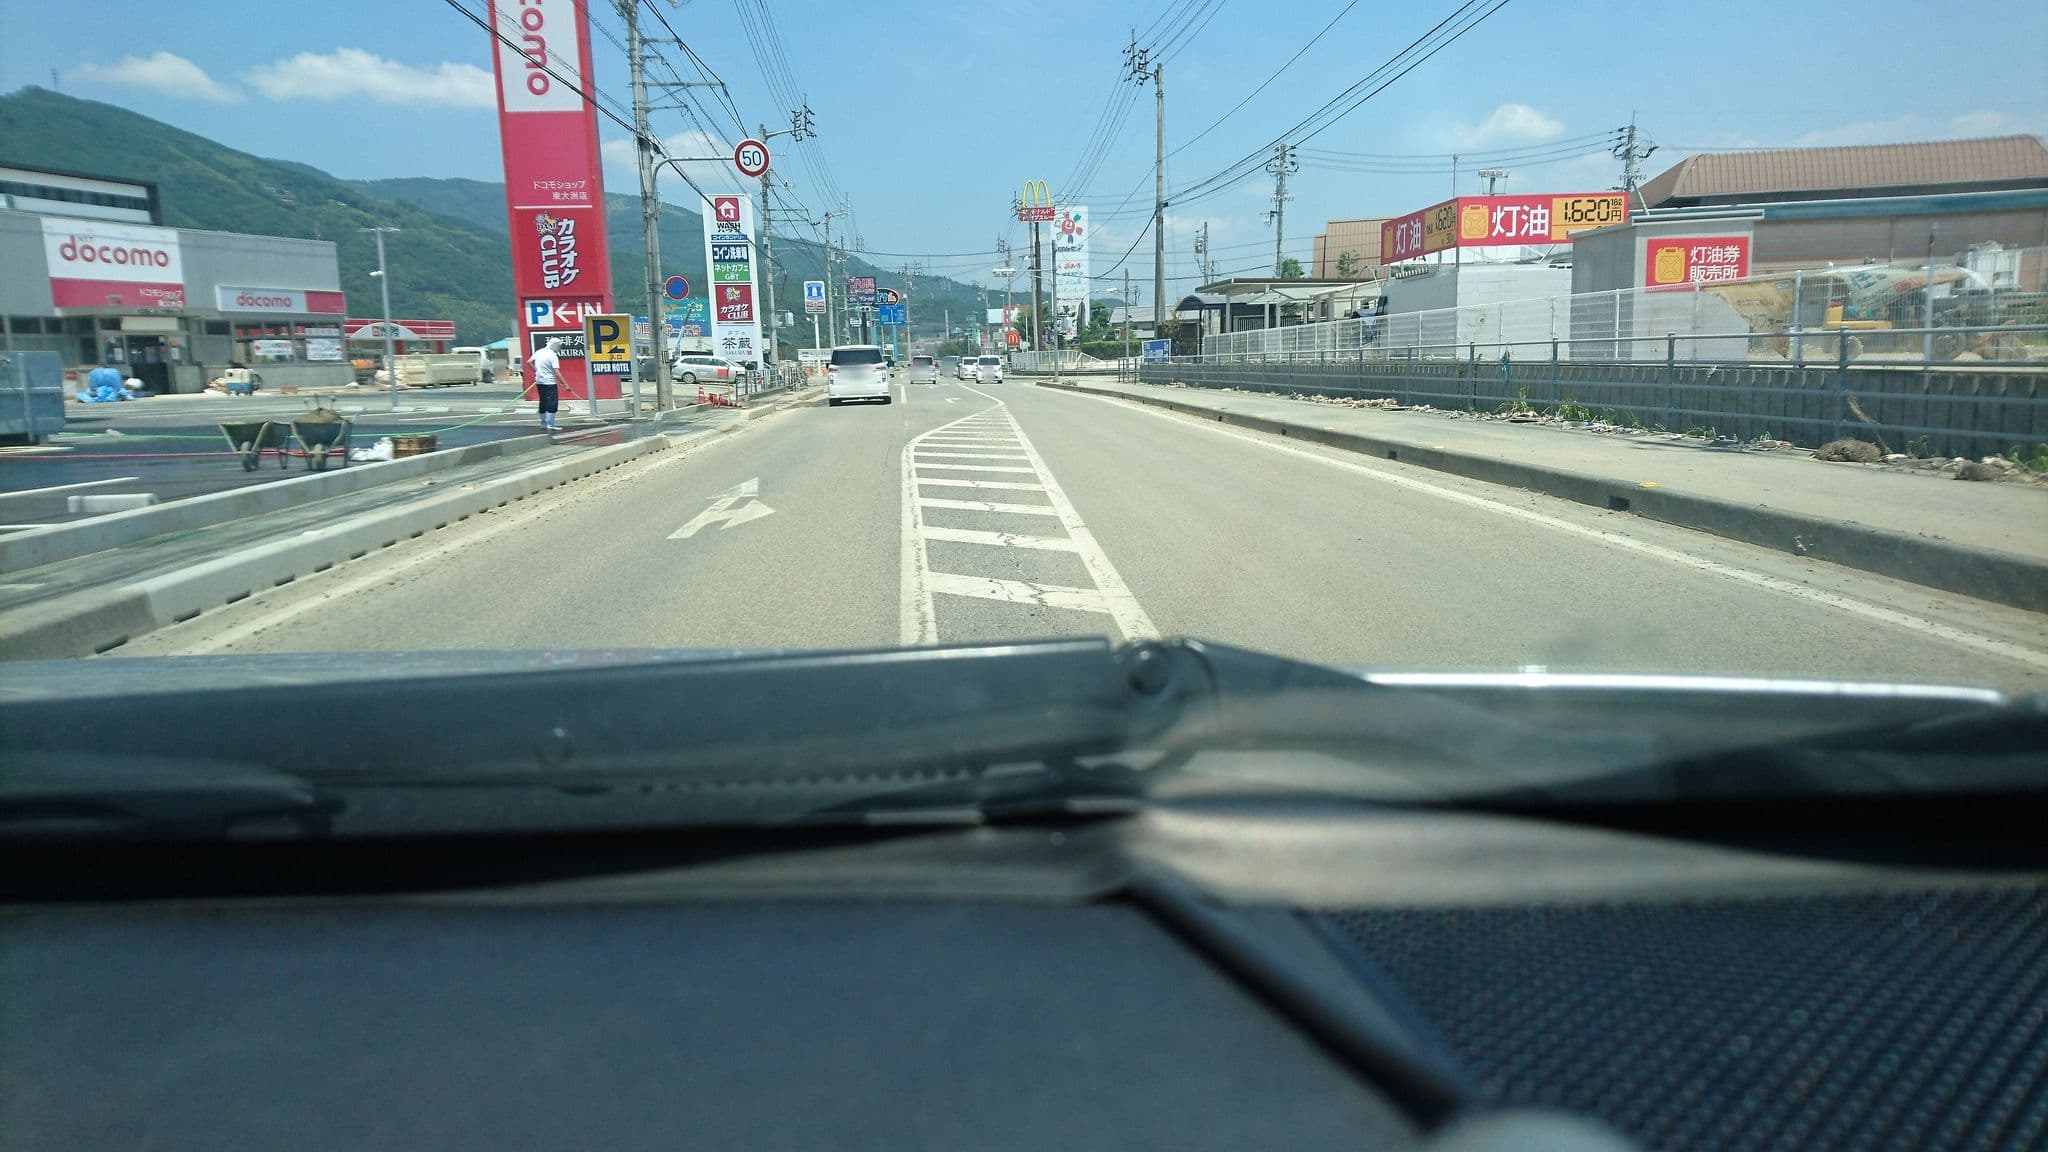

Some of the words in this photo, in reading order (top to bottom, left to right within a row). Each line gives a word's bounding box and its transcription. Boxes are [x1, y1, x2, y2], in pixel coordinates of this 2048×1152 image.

[519, 0, 549, 96] omo
[742, 150, 762, 167] 50
[533, 180, 586, 190] ドコモショップ
[1491, 203, 1550, 238] 灯油
[1564, 199, 1610, 223] 1,620
[716, 222, 741, 230] WASH
[1395, 218, 1422, 254] 灯油
[59, 234, 169, 268] docomo
[557, 218, 580, 285] カラオケ
[1690, 245, 1741, 264] 灯油券
[540, 234, 561, 290] CLUB
[714, 263, 749, 272] ネットカフェ
[1689, 263, 1739, 282] 販売所
[235, 294, 293, 308] docomo
[720, 303, 749, 314] カラオケ
[530, 302, 550, 325] P
[576, 301, 603, 324] IN
[727, 310, 749, 320] CLUB
[592, 319, 620, 354] P
[722, 337, 753, 350] 茶蔵
[593, 362, 611, 373] SUPER
[612, 362, 630, 373] HOTEL
